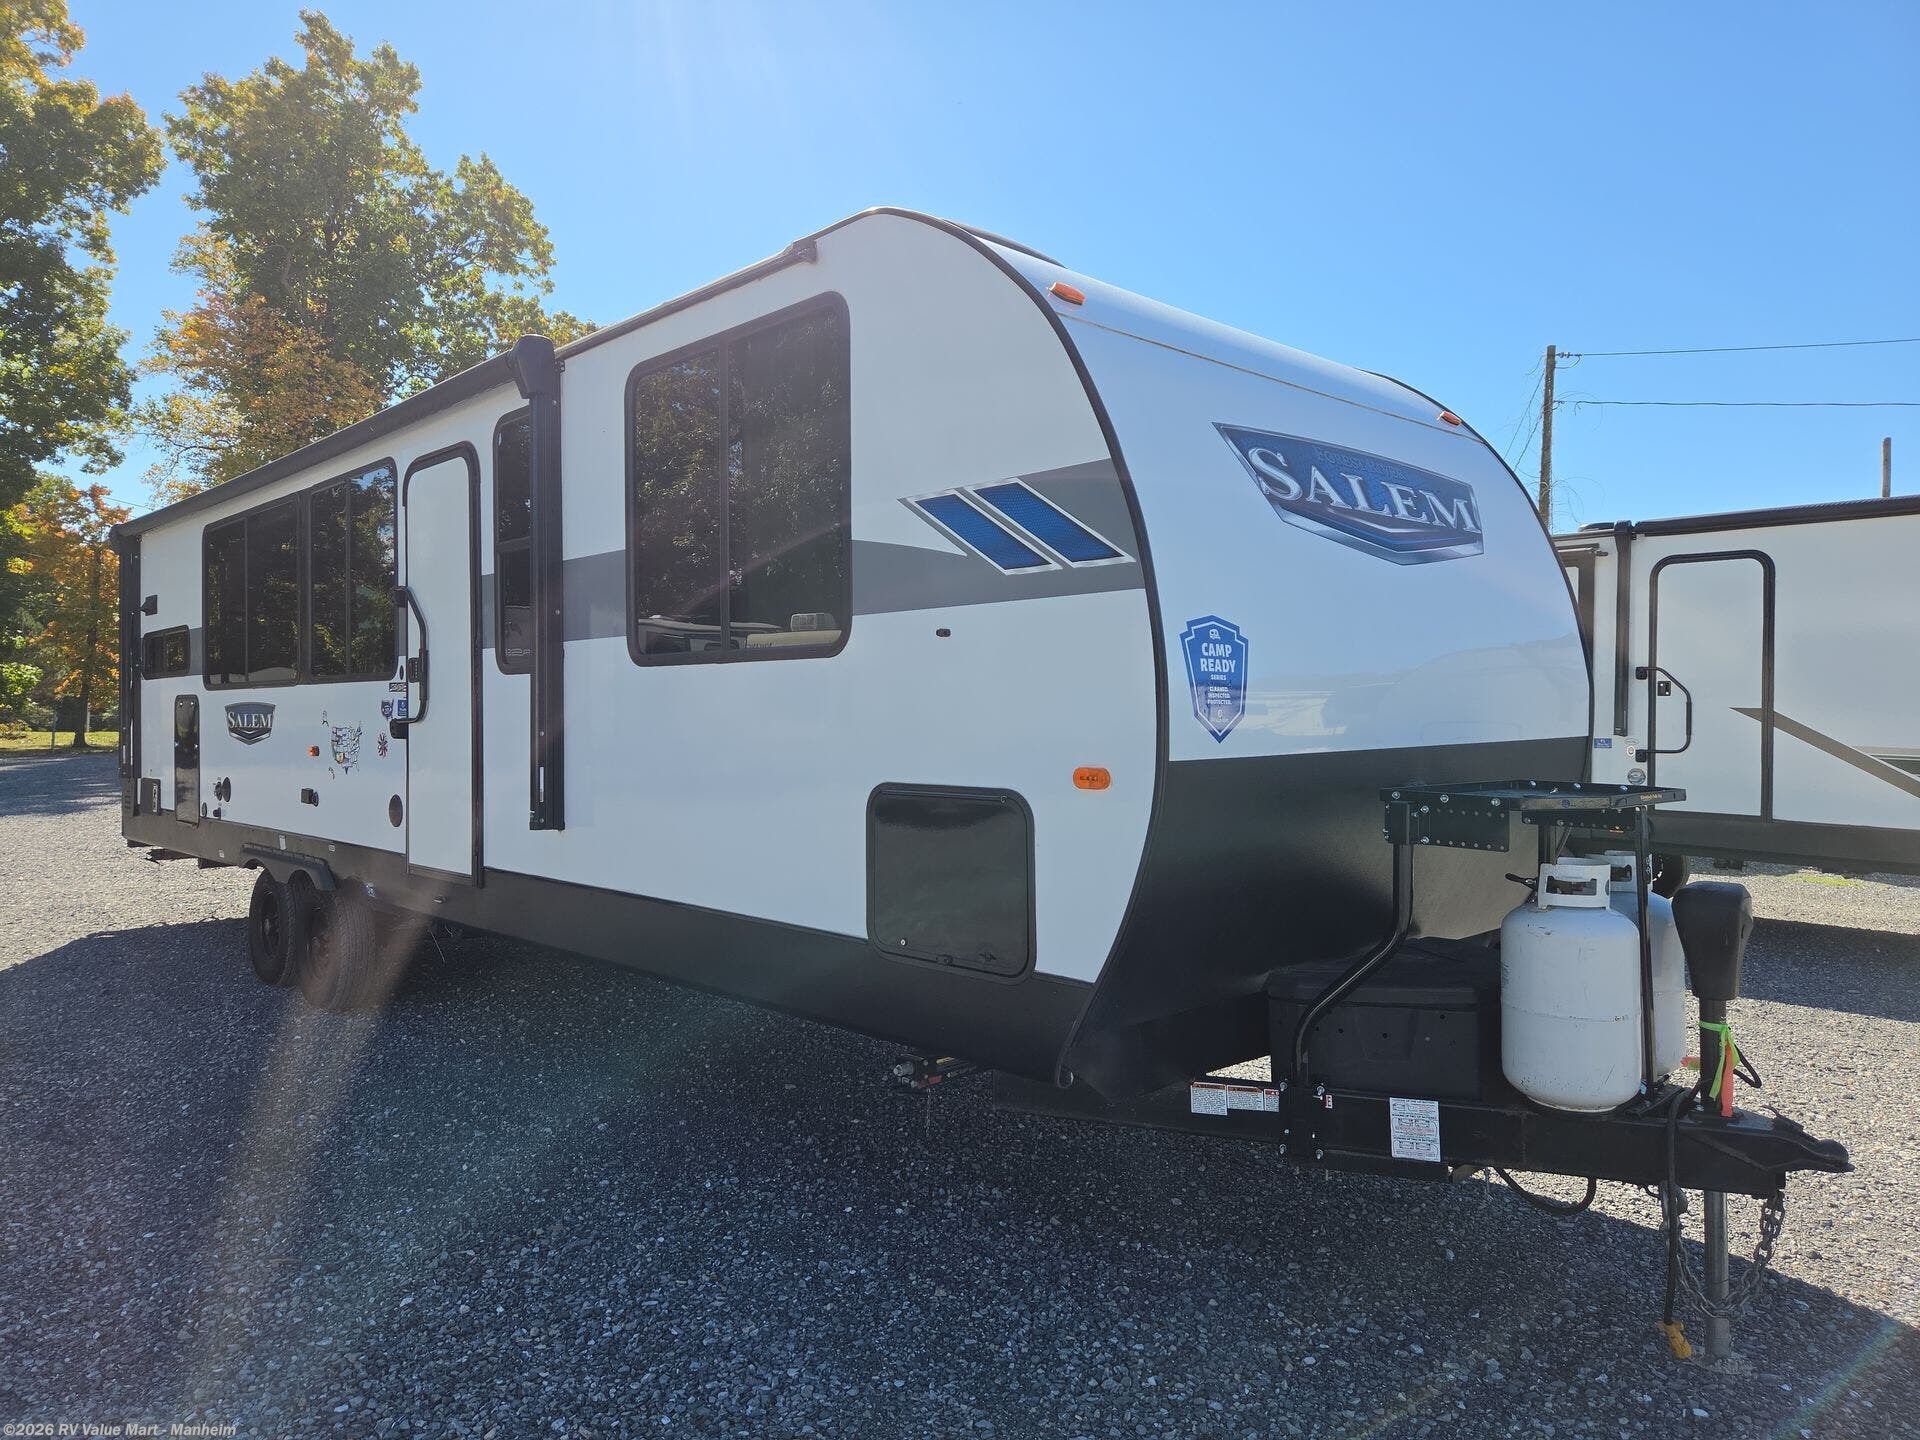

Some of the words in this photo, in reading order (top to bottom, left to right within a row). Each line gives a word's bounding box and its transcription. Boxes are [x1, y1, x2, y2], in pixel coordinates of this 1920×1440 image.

[1249, 447, 1482, 534] SALEM
[1201, 642, 1232, 657] CAMP
[1200, 658, 1236, 673] READY
[228, 711, 272, 728] SALEM
